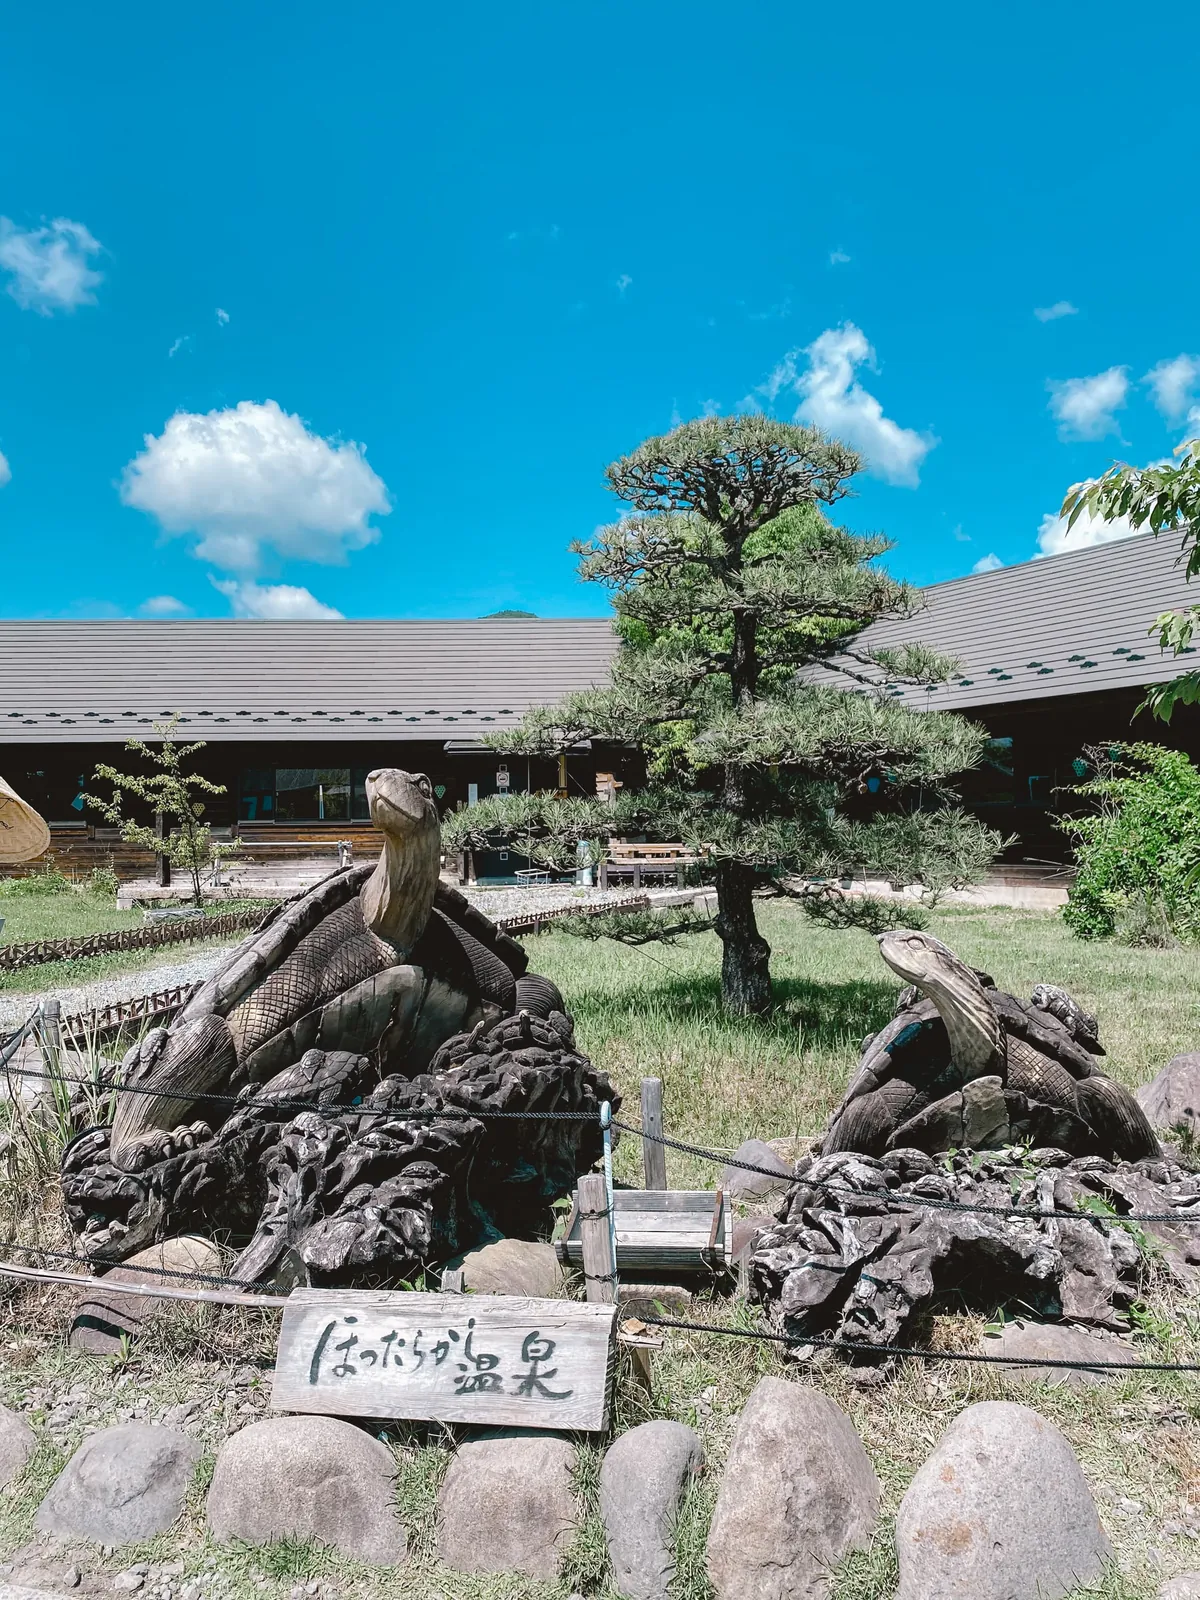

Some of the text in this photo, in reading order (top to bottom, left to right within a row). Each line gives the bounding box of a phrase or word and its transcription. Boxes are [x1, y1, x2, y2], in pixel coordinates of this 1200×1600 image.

[309, 1316, 573, 1400] ほったらかし温泉
